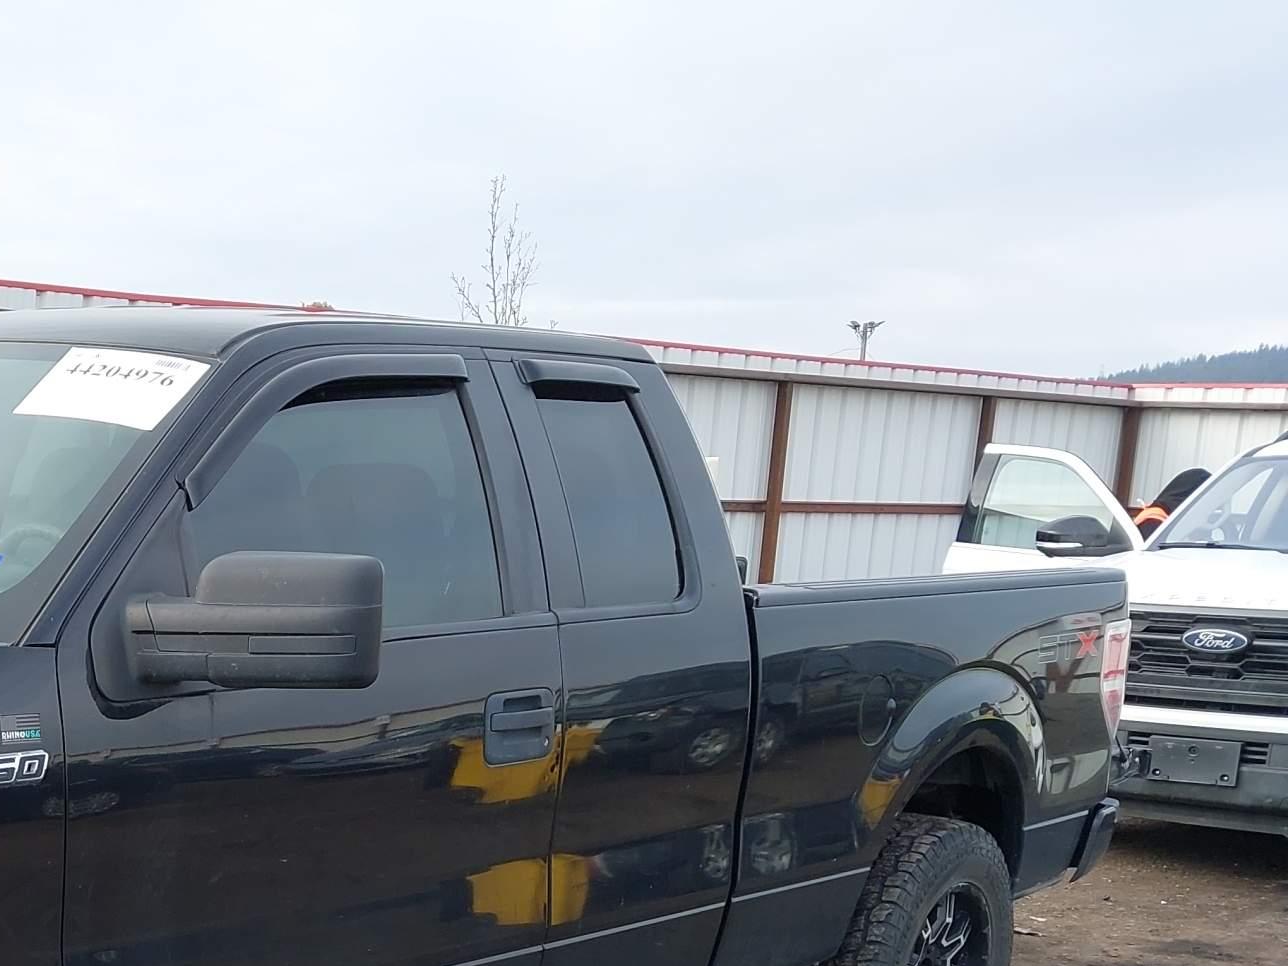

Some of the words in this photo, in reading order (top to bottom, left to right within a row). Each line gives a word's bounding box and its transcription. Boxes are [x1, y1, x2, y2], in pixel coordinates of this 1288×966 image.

[65, 363, 174, 387] 44204976
[1039, 630, 1099, 663] STX
[1194, 631, 1234, 648] Ford
